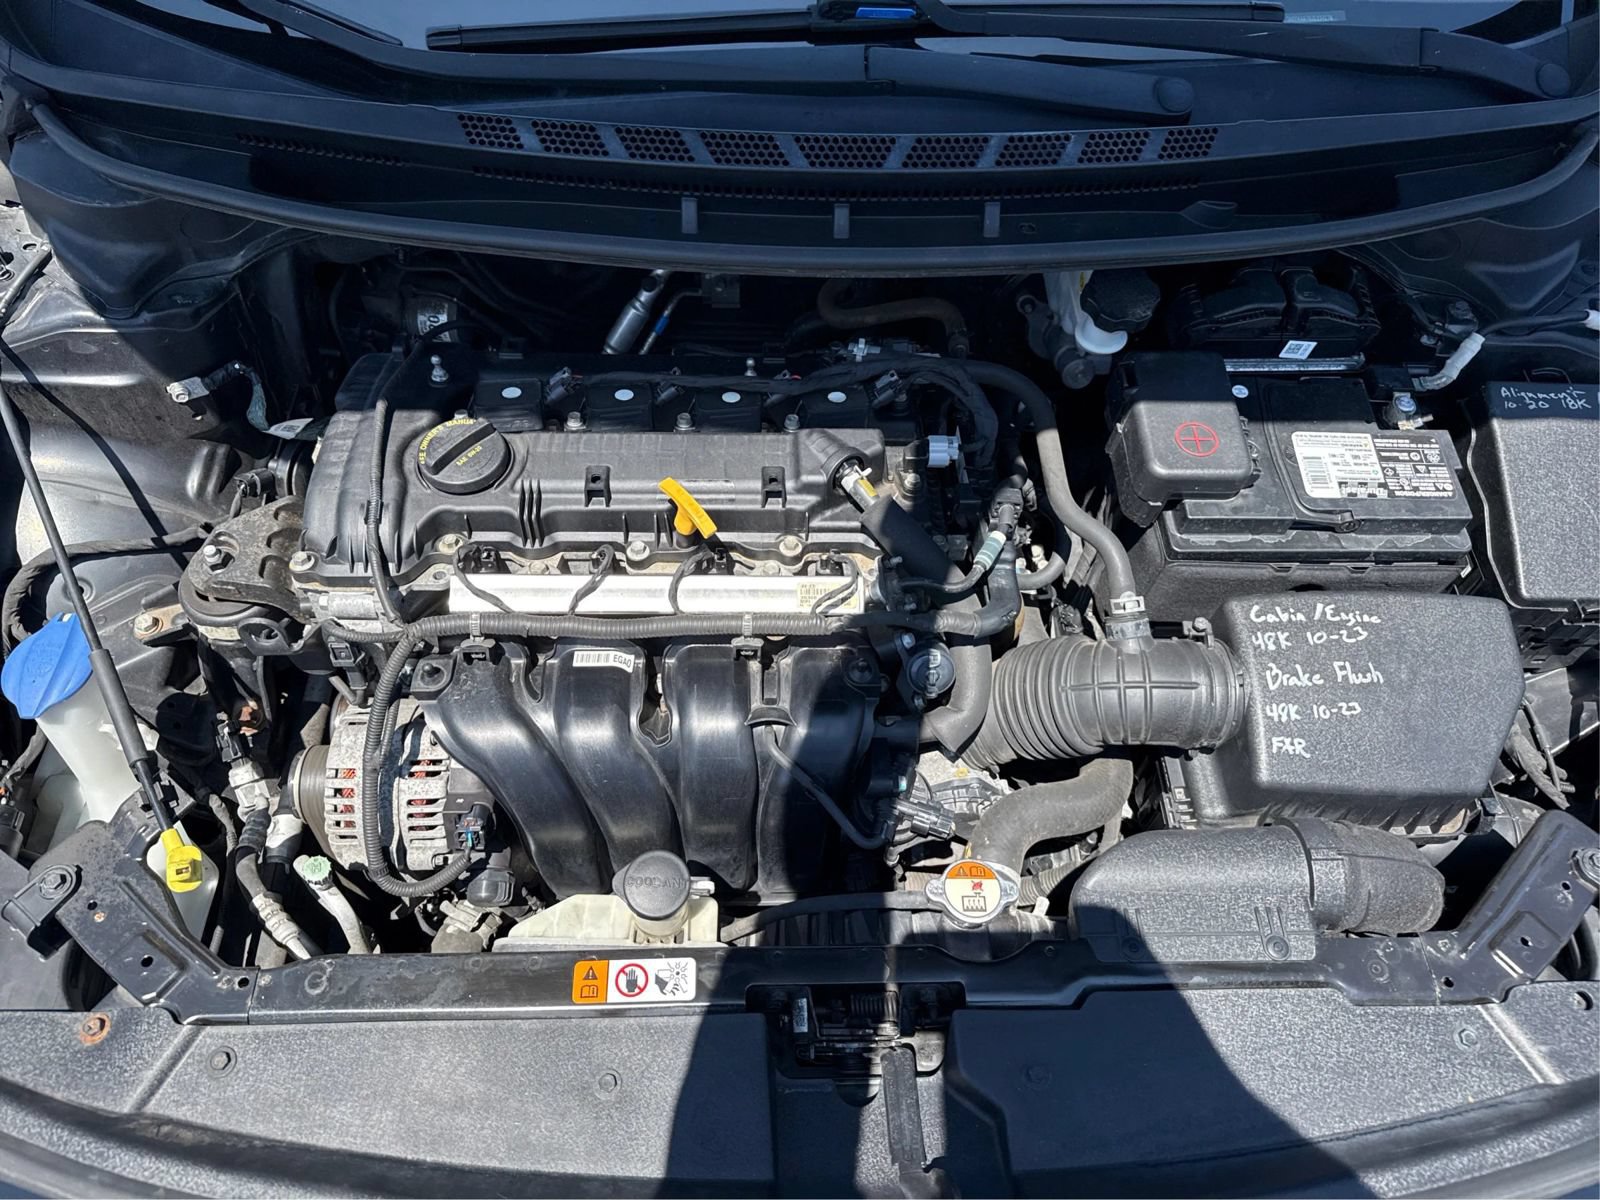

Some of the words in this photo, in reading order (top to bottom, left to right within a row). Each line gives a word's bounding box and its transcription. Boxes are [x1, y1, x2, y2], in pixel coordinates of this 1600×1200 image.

[1562, 399, 1592, 410] 18K
[1250, 605, 1306, 622] Cabin
[1252, 631, 1292, 651] 48K
[1306, 626, 1368, 645] 10-23
[1266, 663, 1324, 690] Brake
[1333, 661, 1384, 684] Flush
[1266, 703, 1301, 723] 48K
[1313, 702, 1361, 719] 10-23
[627, 876, 687, 889] COOLANT
